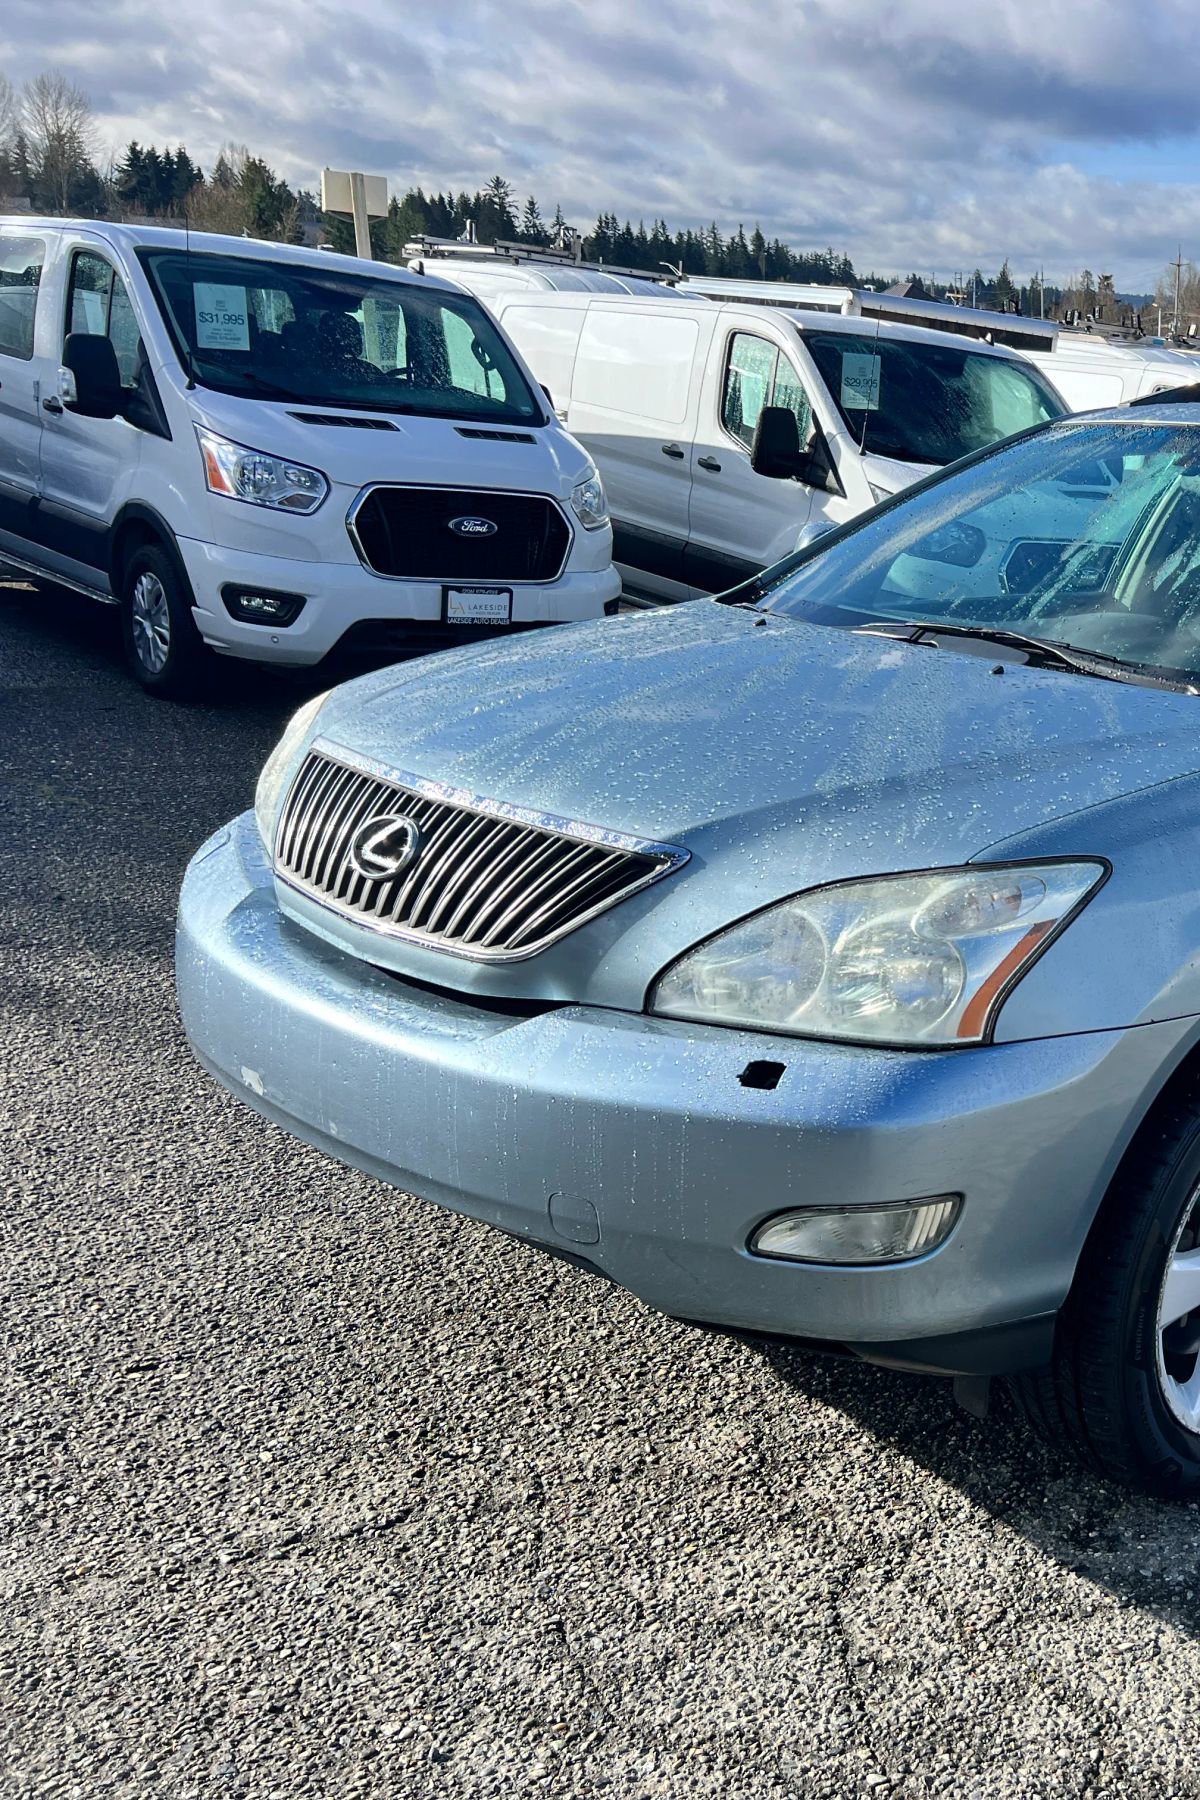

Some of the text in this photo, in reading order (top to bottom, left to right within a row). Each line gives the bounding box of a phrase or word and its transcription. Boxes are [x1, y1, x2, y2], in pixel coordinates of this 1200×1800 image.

[198, 311, 245, 326] $31,995
[461, 519, 489, 533] Ford
[472, 617, 490, 625] AUTO
